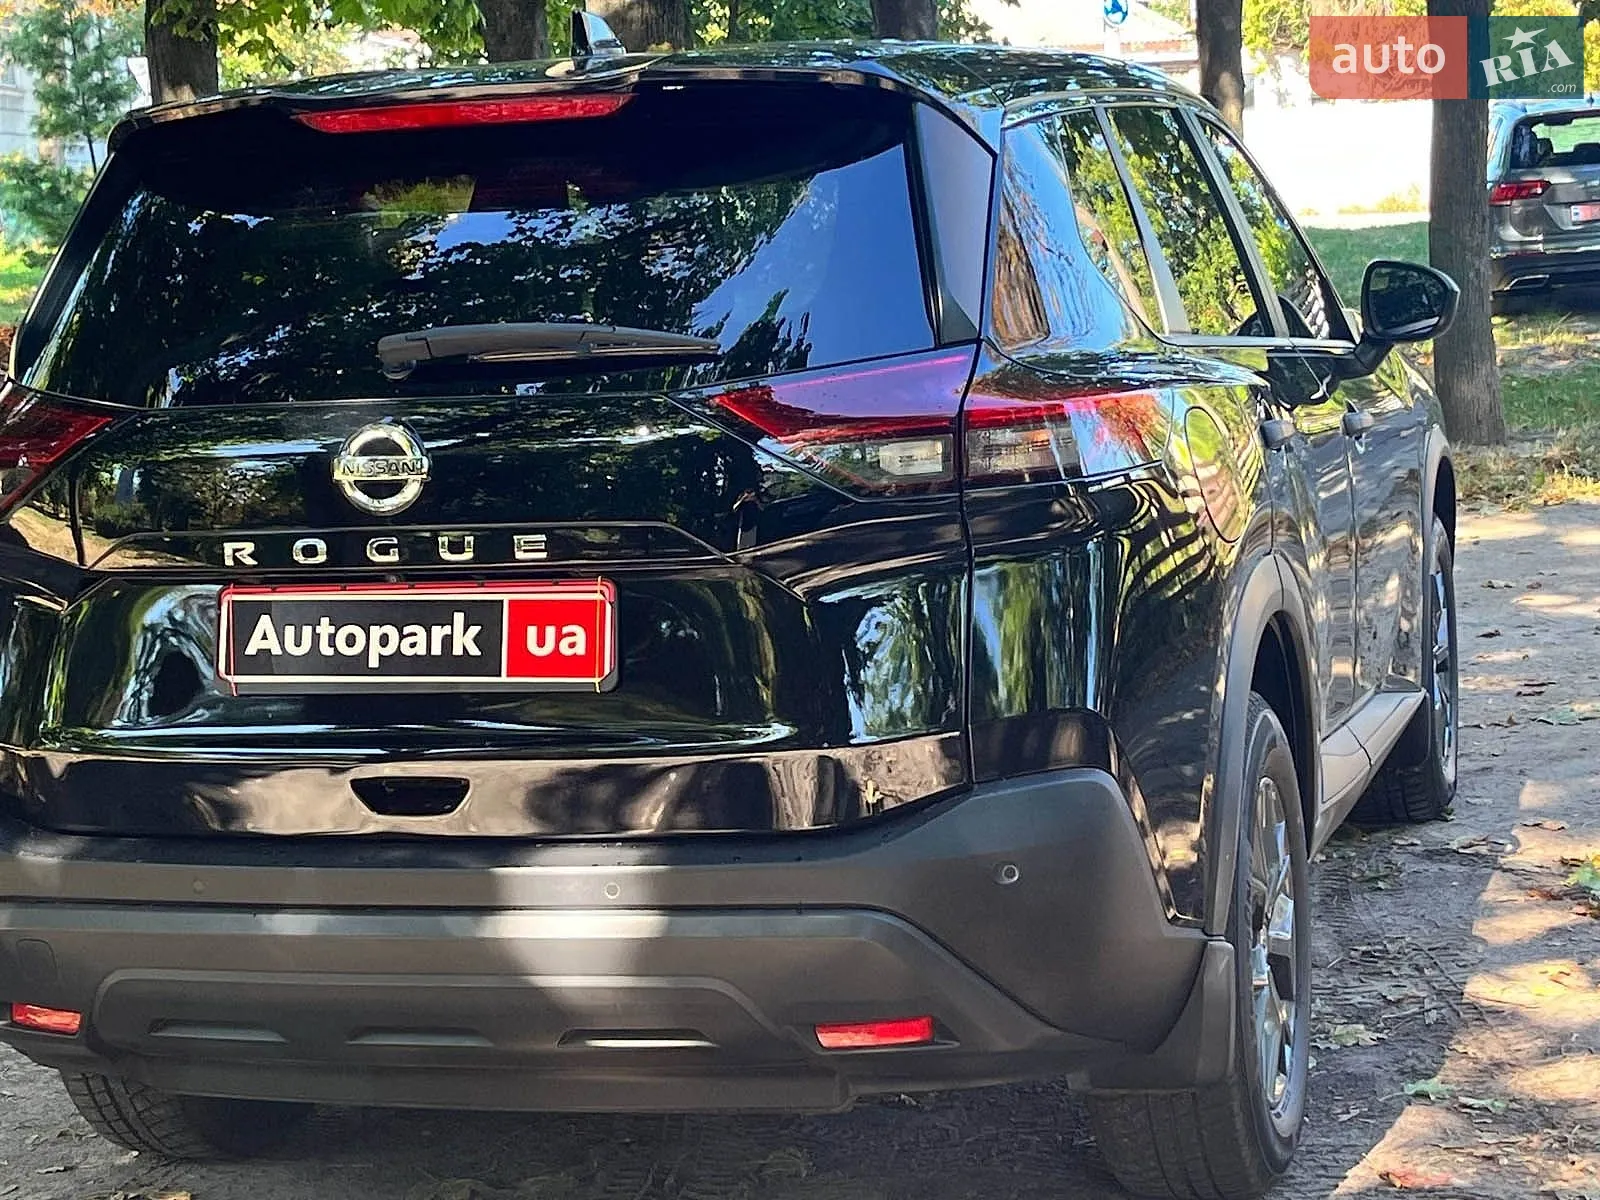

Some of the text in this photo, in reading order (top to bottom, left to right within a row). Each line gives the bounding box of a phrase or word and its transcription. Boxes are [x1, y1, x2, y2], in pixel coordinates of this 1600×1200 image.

[341, 459, 417, 475] NISSAN
[223, 535, 548, 567] ROGUE
[244, 611, 587, 668] Autopark ua
